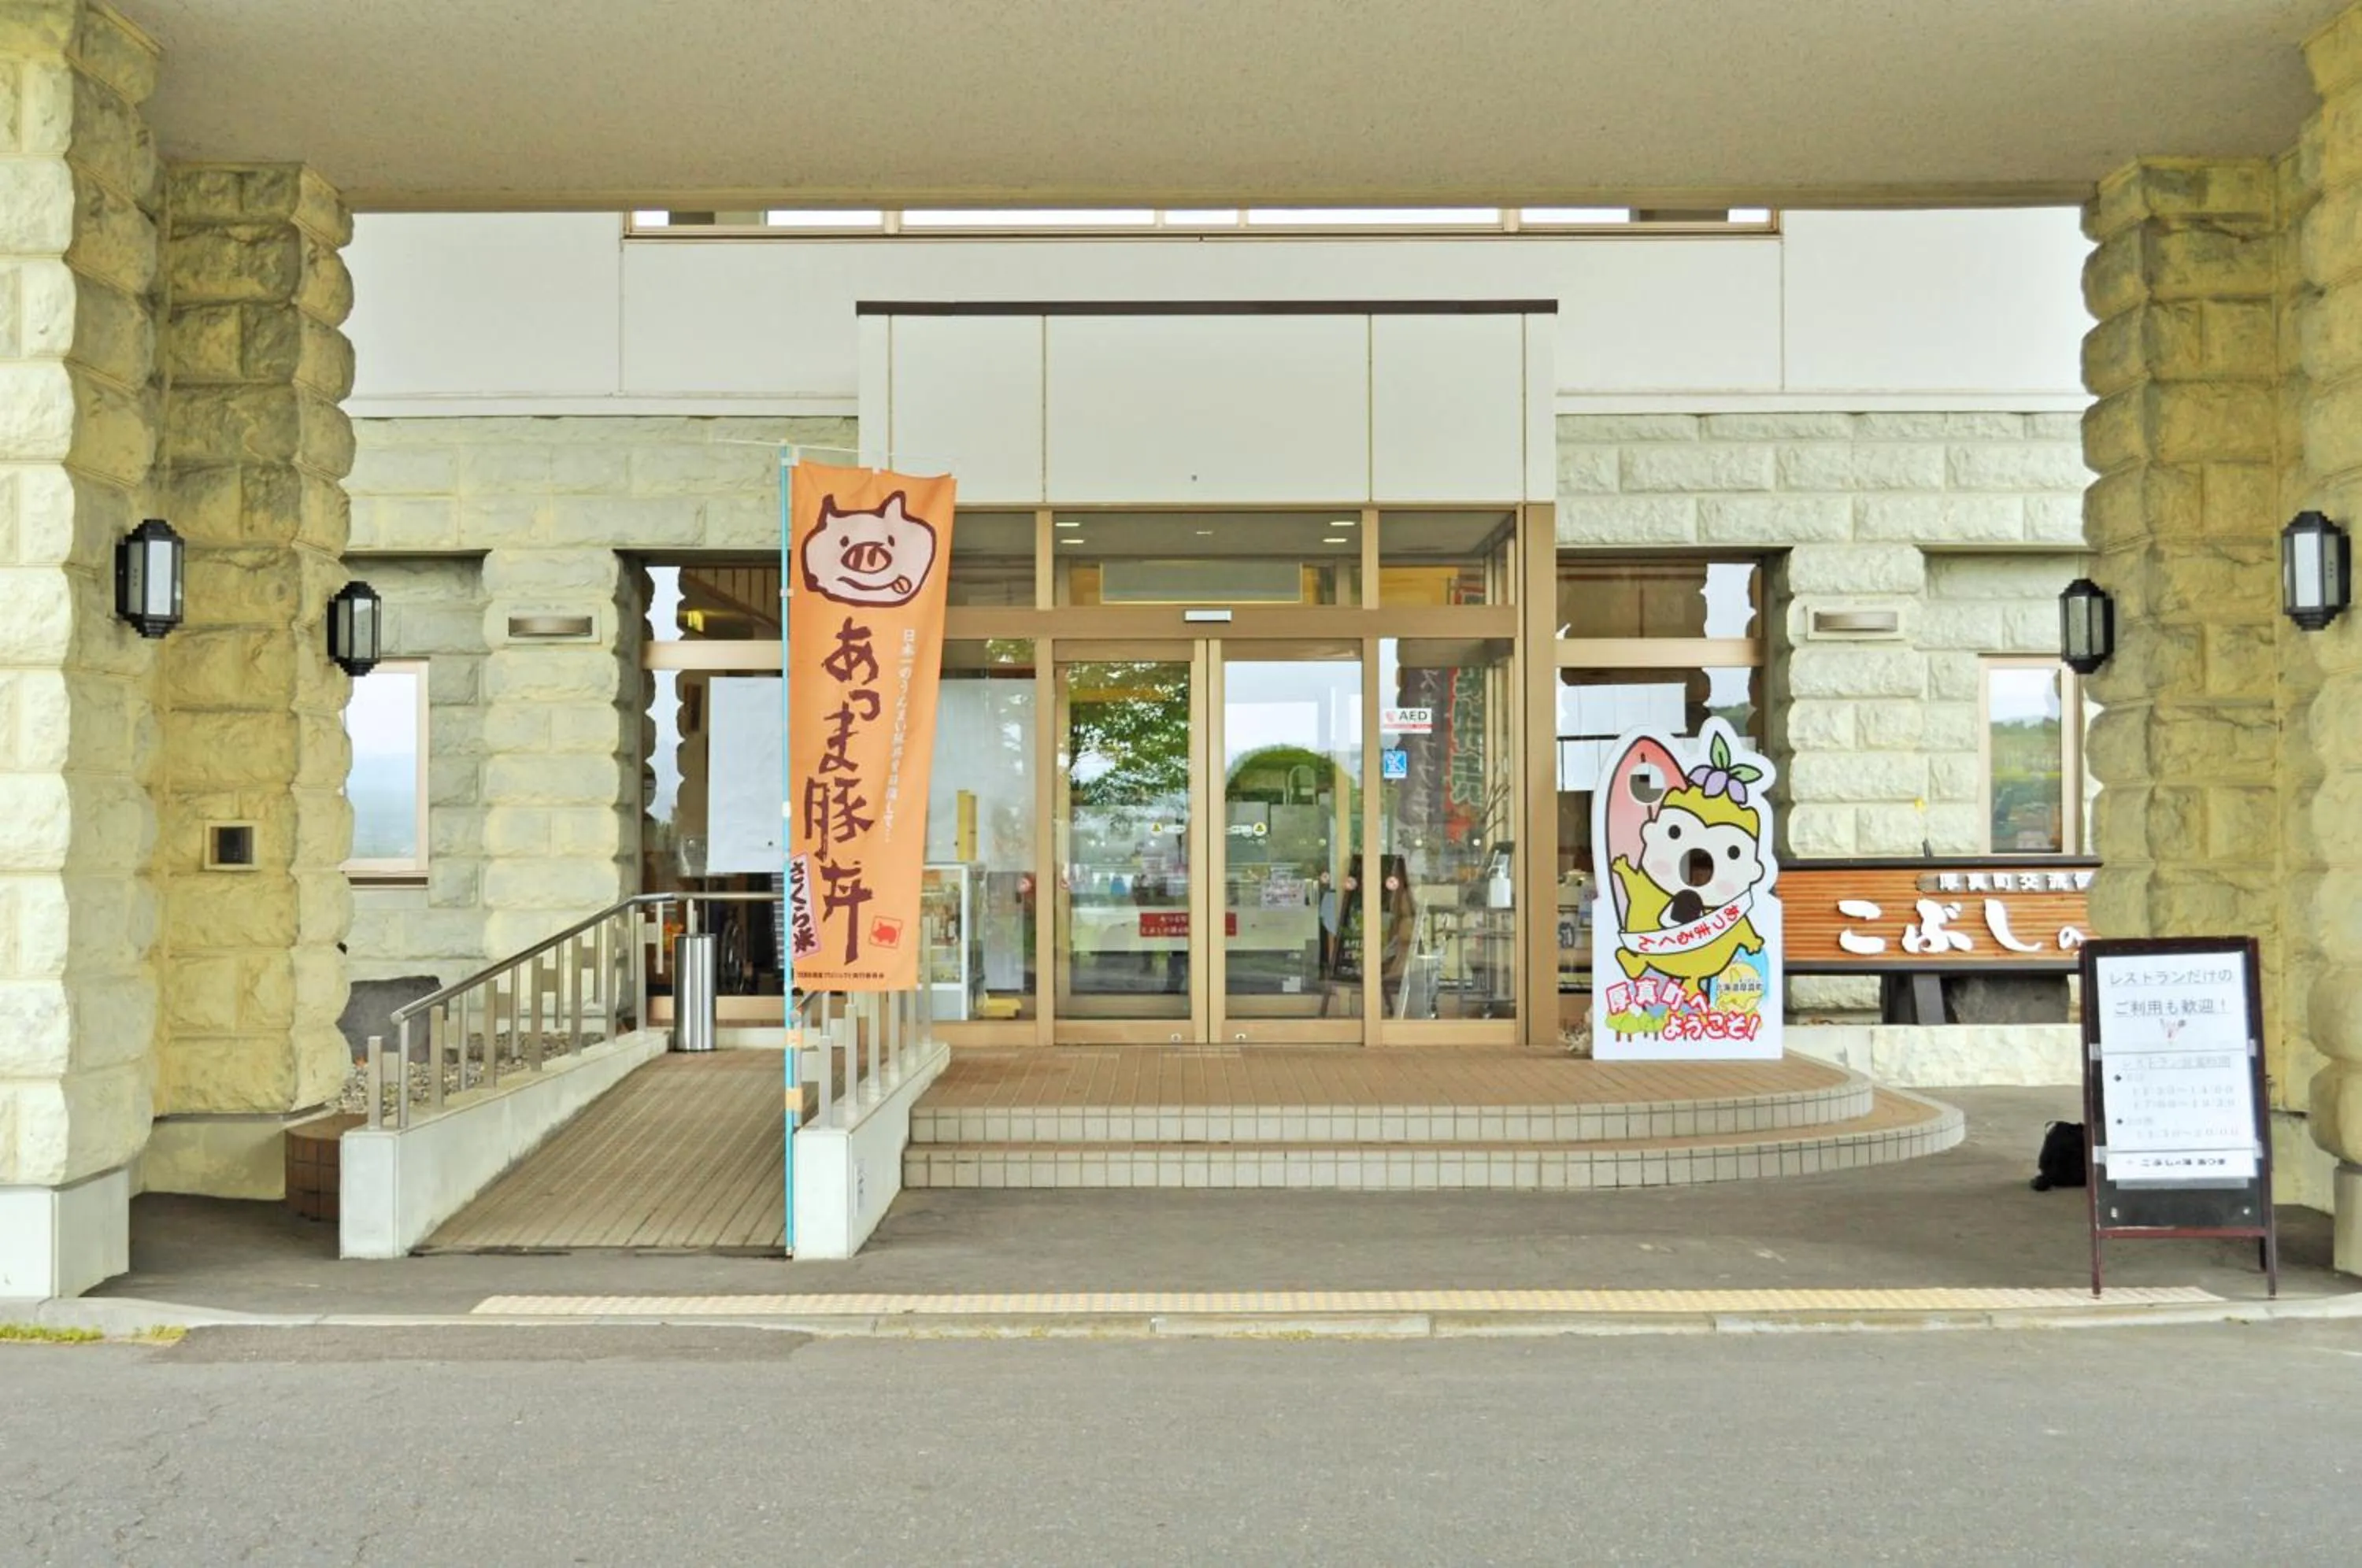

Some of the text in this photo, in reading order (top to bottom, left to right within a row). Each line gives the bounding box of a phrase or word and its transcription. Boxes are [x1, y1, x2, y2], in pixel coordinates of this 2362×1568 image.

[1399, 710, 1427, 721] AED
[805, 616, 880, 965] あつま豚丼
[790, 860, 816, 952] さくら米
[2110, 969, 2232, 986] レストランだけの
[1606, 978, 1709, 1015] 厚真町へ
[2116, 998, 2227, 1016] ご利用も歓迎！
